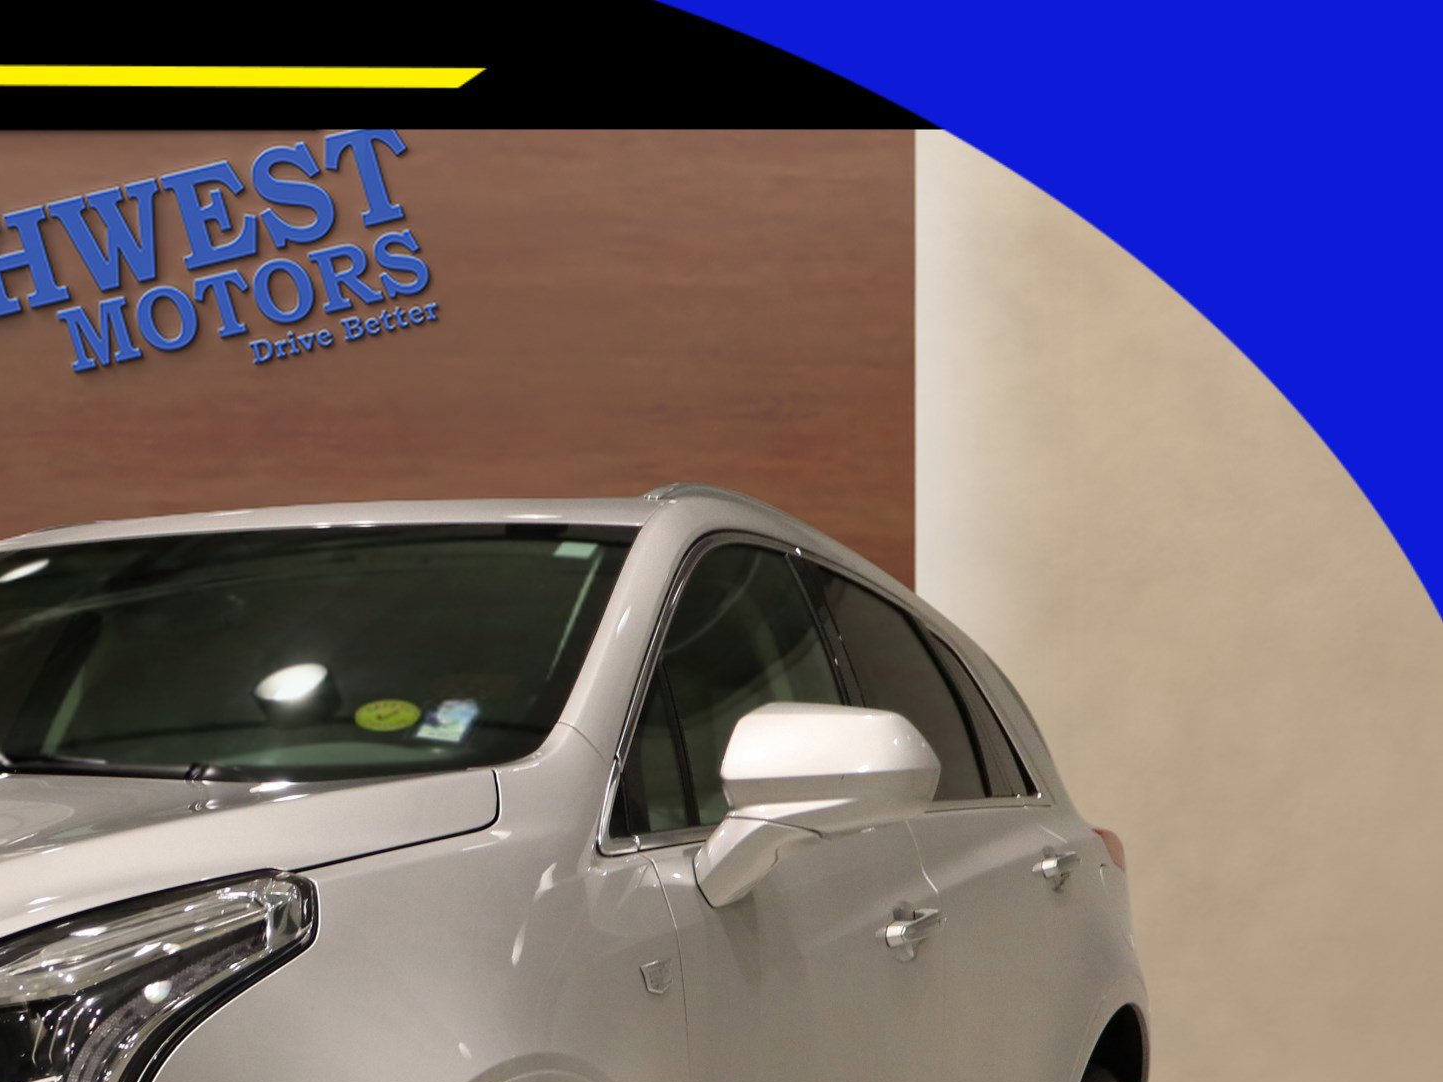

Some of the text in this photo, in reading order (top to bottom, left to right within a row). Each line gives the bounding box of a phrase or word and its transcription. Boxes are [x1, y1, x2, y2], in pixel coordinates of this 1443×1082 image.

[57, 229, 431, 374] MOTORS
[249, 302, 439, 364] Drive Better
